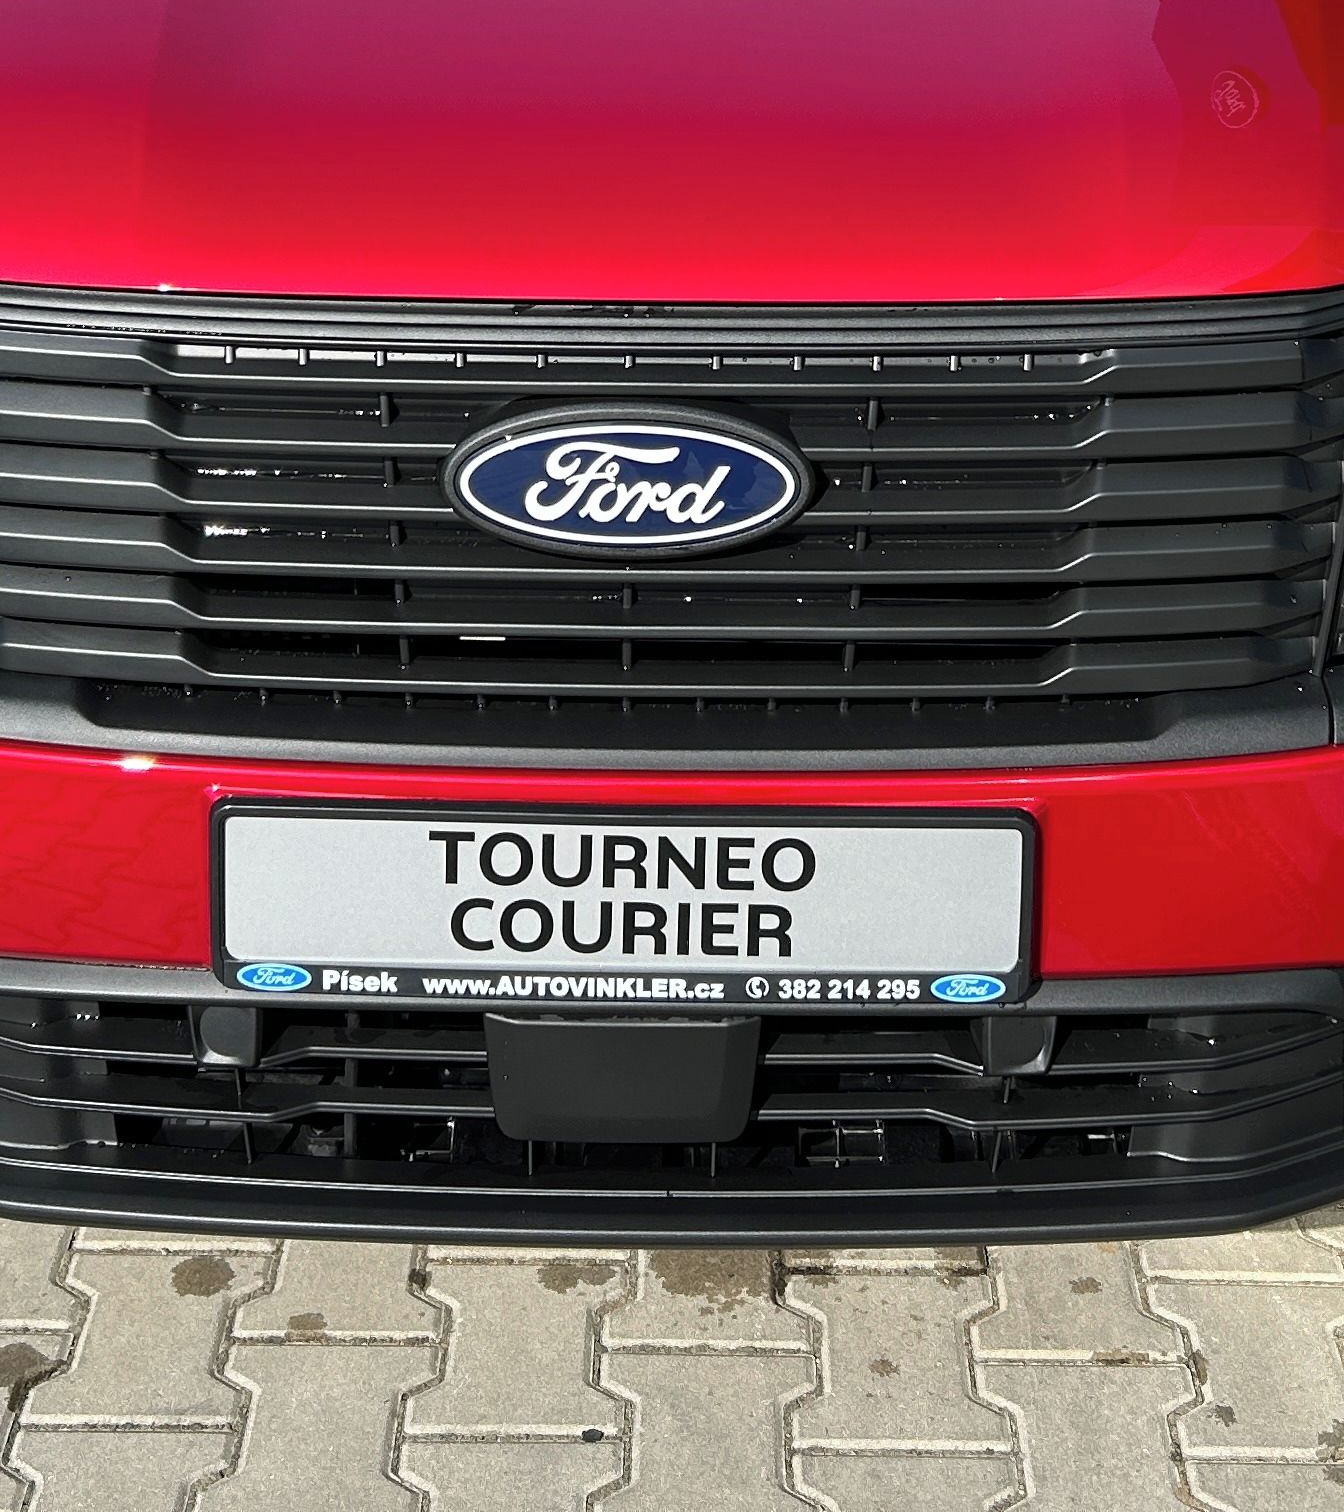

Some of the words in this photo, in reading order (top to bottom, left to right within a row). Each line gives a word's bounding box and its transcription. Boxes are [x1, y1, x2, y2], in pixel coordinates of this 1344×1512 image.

[524, 442, 731, 524] Ford
[428, 830, 816, 892] TOURNEO
[450, 898, 793, 958] COURIER
[252, 967, 295, 986] Ford
[321, 969, 398, 993] Písek
[422, 974, 725, 999] www.AUTOVINKLER.cz
[778, 978, 821, 999] 382
[827, 978, 870, 1000] 214
[876, 979, 921, 1000] 295
[945, 978, 989, 997] Ford
